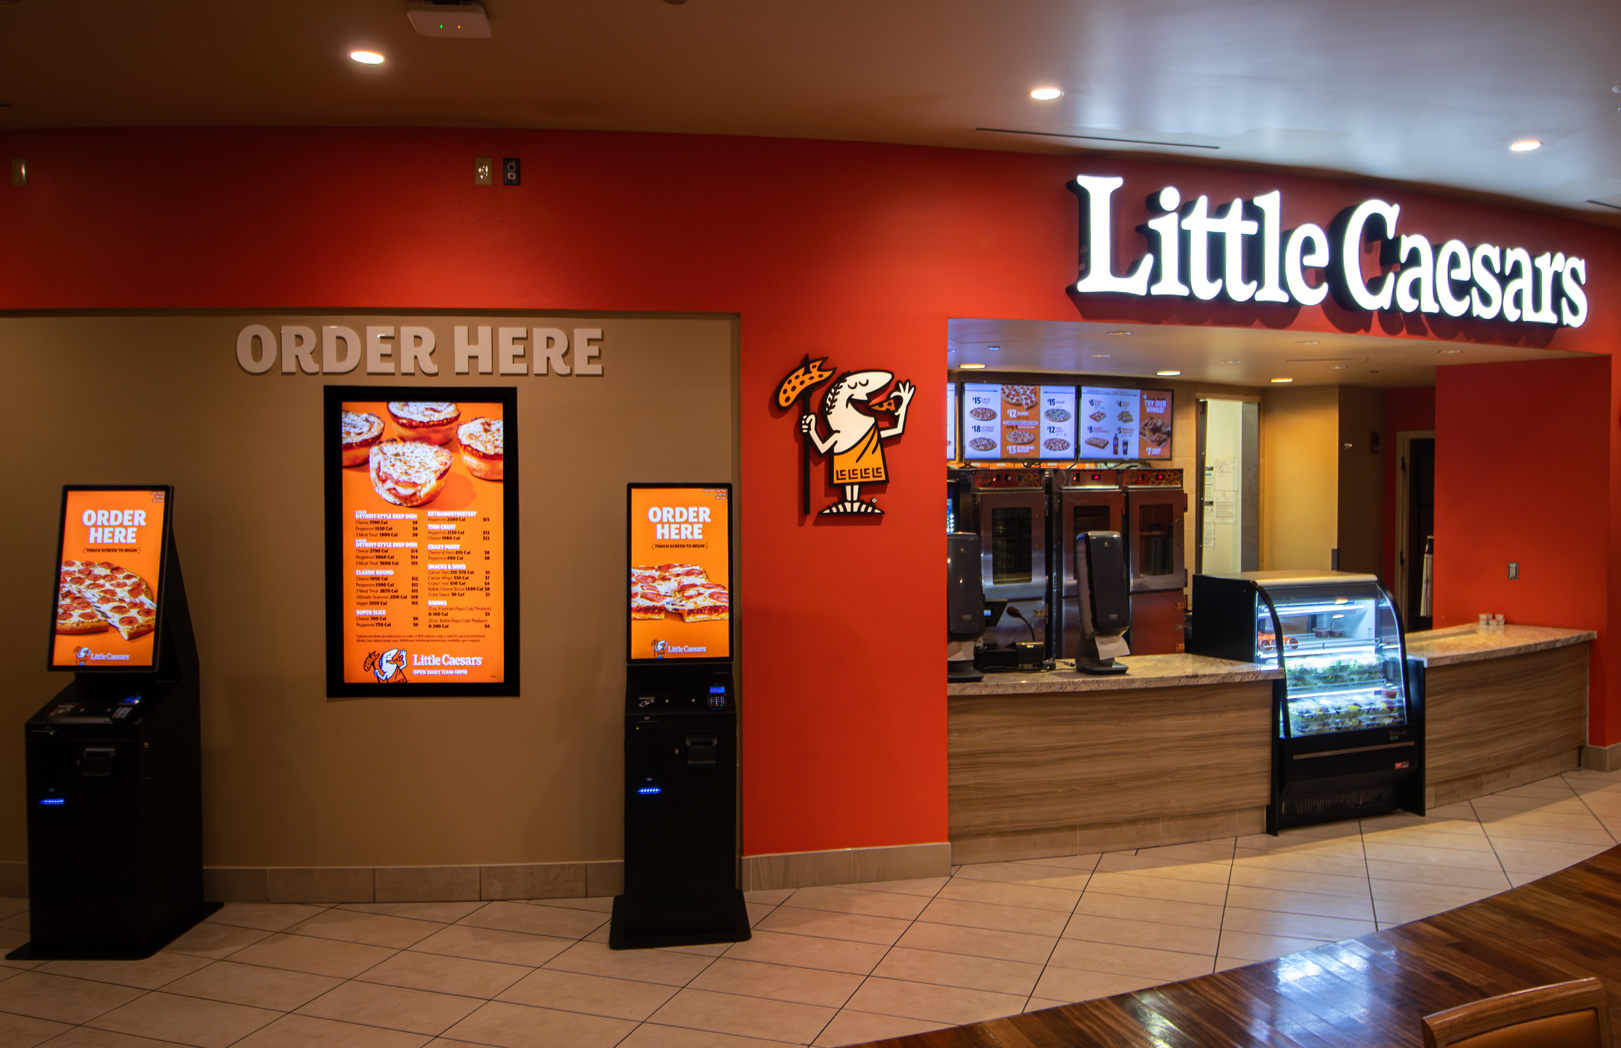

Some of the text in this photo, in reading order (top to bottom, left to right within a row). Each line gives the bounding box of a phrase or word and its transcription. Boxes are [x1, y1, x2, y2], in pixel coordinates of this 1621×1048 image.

[1077, 174, 1589, 328] Little Caesars
[236, 324, 604, 377] ORDER HERE
[1007, 409, 1017, 418] $12
[1007, 446, 1016, 454] $13
[82, 510, 146, 526] ORDER
[648, 507, 711, 523] ORDER
[88, 527, 138, 544] HERE
[656, 524, 703, 540] HERE
[668, 645, 706, 654] Little Caesars
[412, 654, 482, 666] Little Caesars
